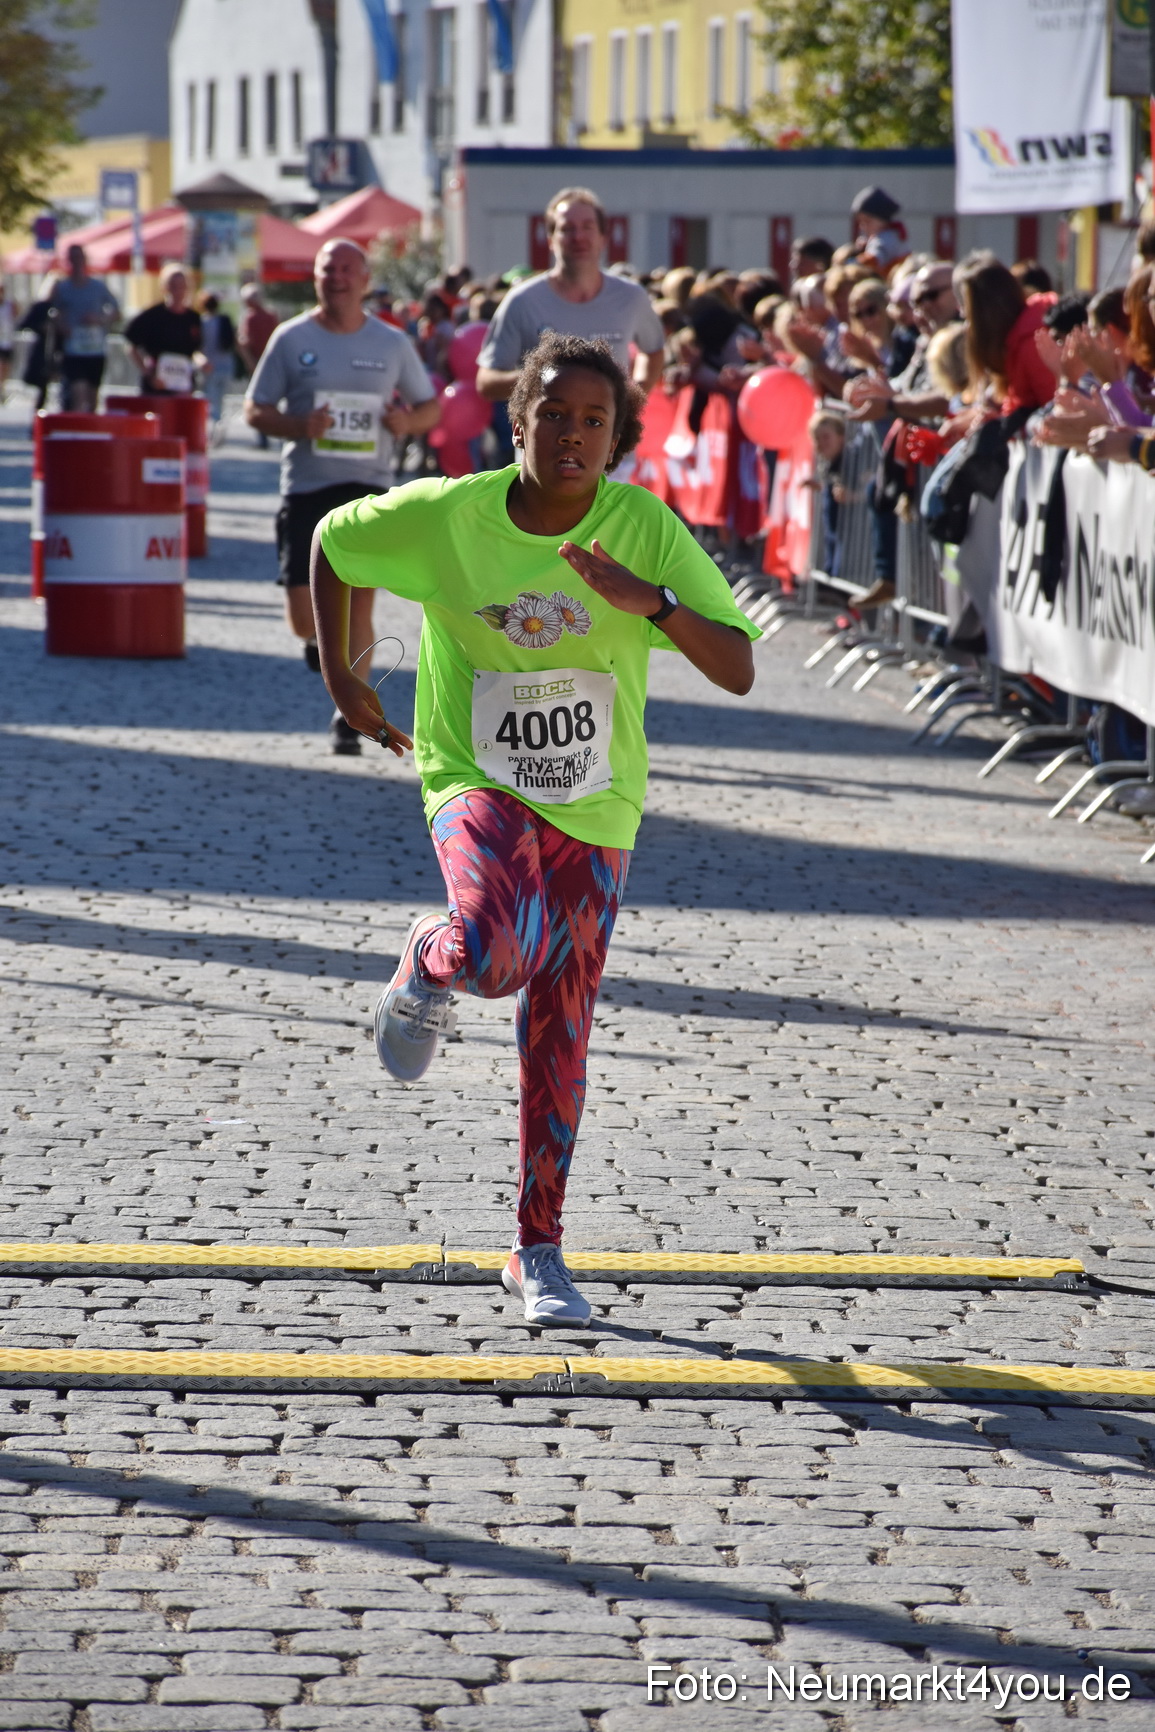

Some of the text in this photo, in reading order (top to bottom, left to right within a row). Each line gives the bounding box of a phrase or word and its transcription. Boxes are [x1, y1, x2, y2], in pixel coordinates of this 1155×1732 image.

[514, 679, 575, 700] BOCK
[495, 700, 596, 751] 4008
[540, 751, 582, 765] Neumarkt
